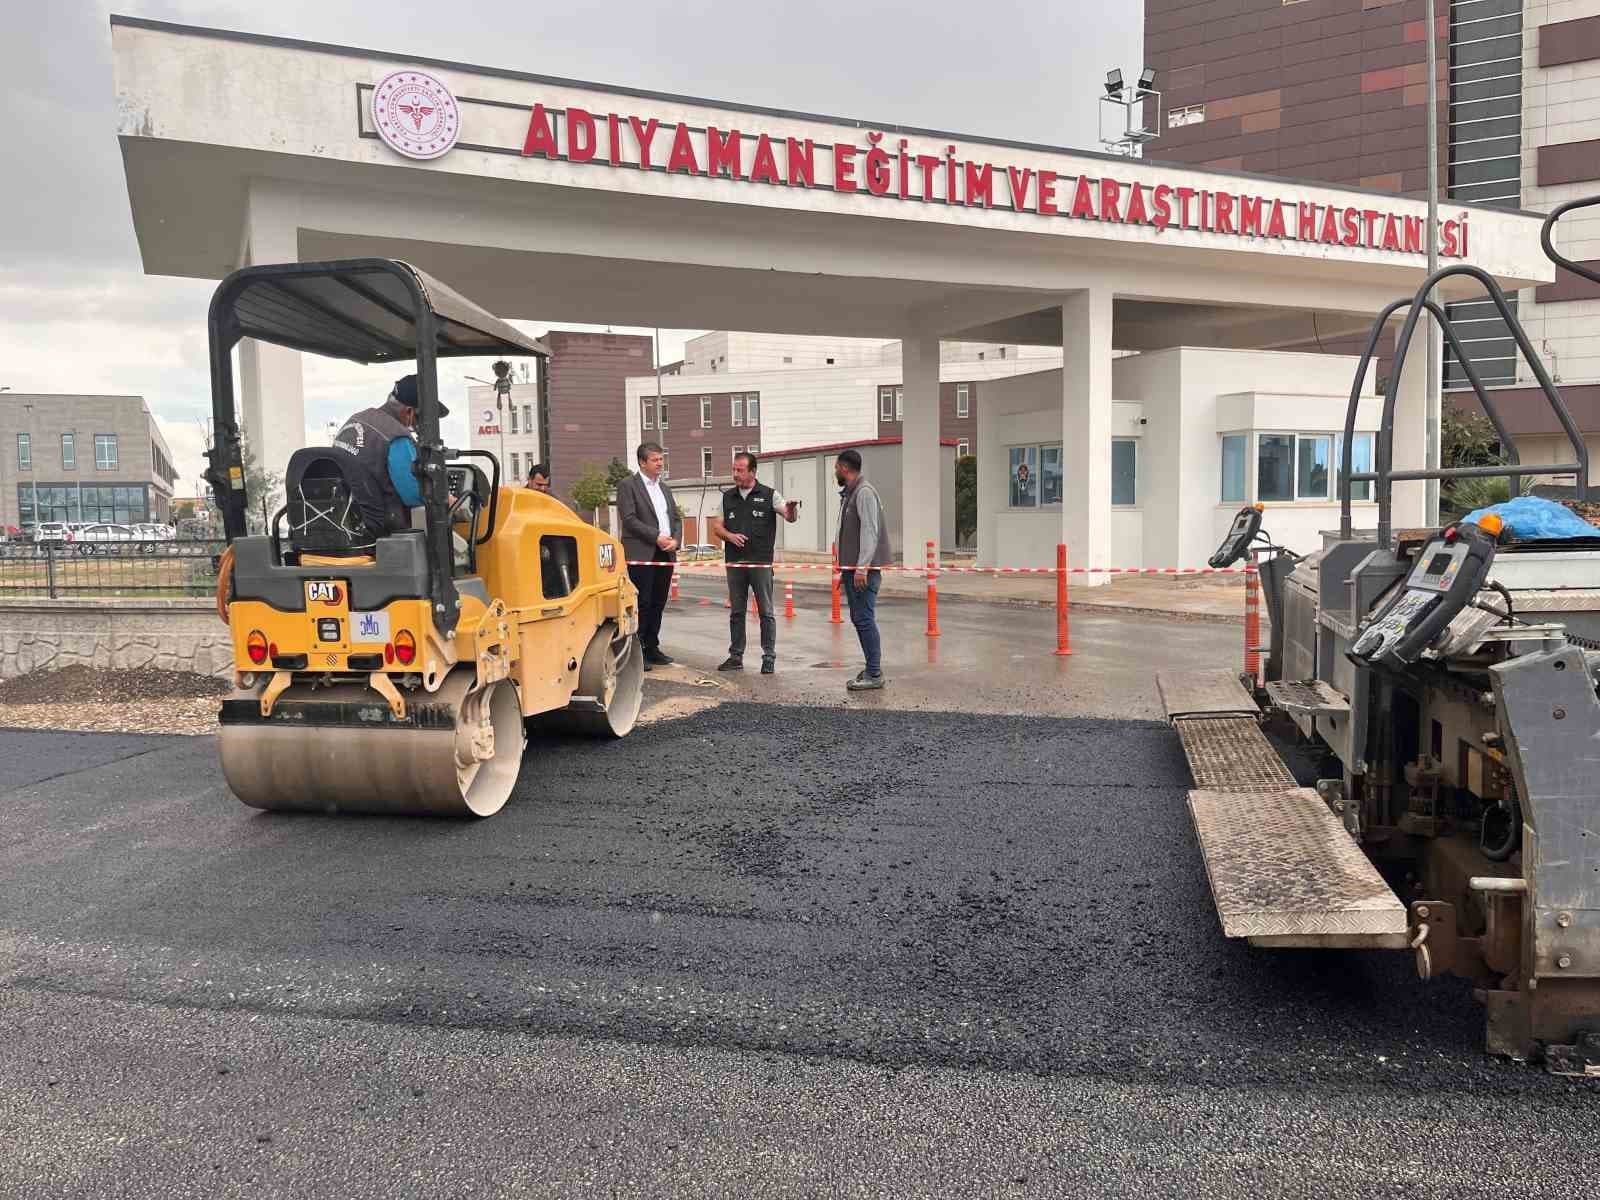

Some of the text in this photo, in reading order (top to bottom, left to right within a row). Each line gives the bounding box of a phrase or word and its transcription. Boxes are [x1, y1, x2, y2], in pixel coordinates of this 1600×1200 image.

[522, 103, 1469, 257] ADIYAMAN EĞİTİM VE ARAŞTIRMA HASTANSİ
[599, 544, 613, 567] CAT
[308, 583, 336, 600] CAT
